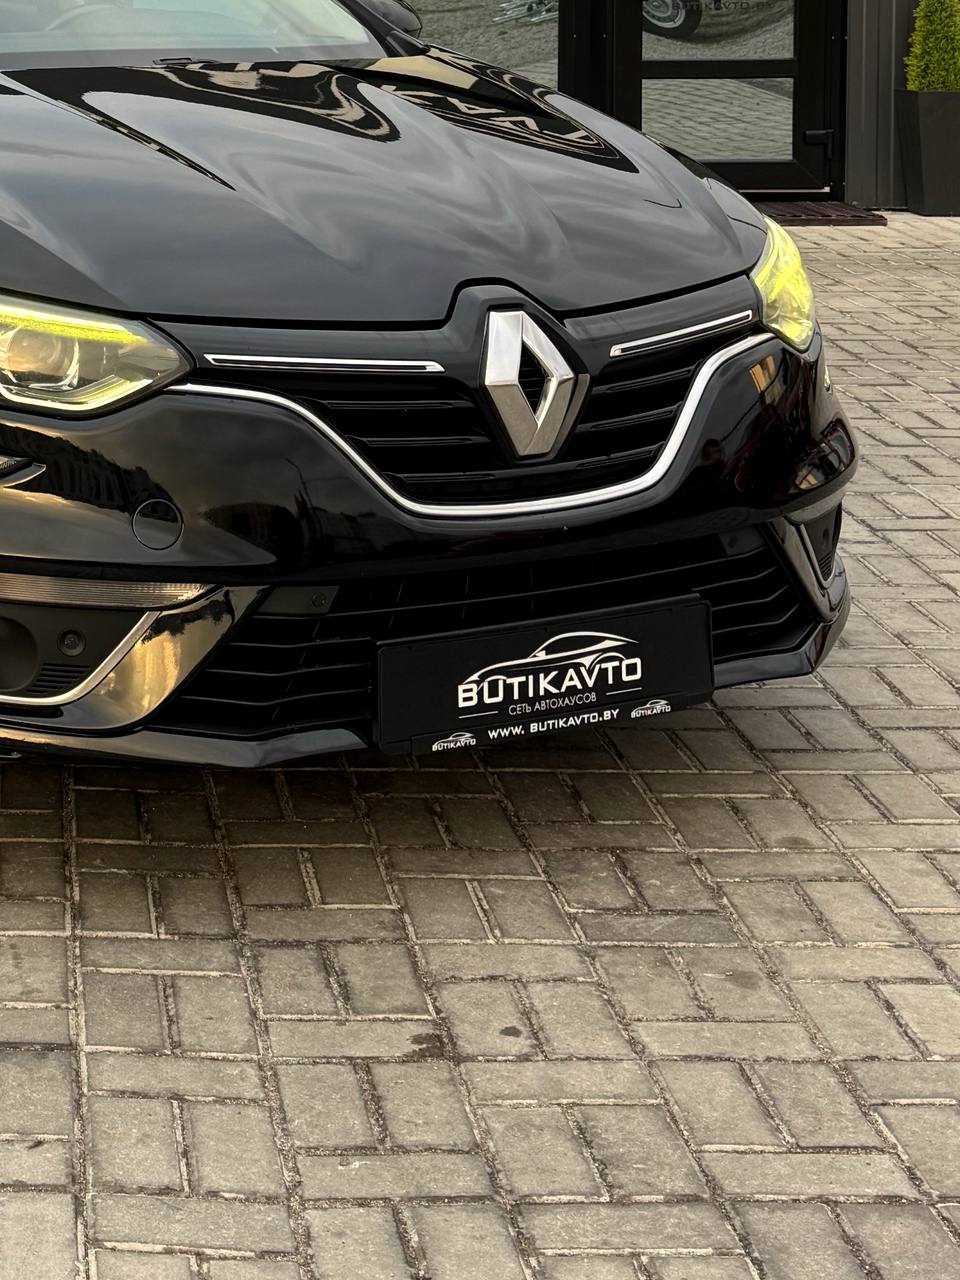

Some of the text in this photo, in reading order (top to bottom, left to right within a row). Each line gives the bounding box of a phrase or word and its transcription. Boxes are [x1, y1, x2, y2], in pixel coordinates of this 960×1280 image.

[457, 657, 642, 709] BUTIKAVTO
[508, 692, 597, 716] СЕТЬ АВТОХАУСОВ
[630, 705, 671, 718] BUTIKAVTO
[488, 708, 620, 740] WWW. BUTIKAVTO.BY
[432, 738, 476, 752] BUTIKAVTO
